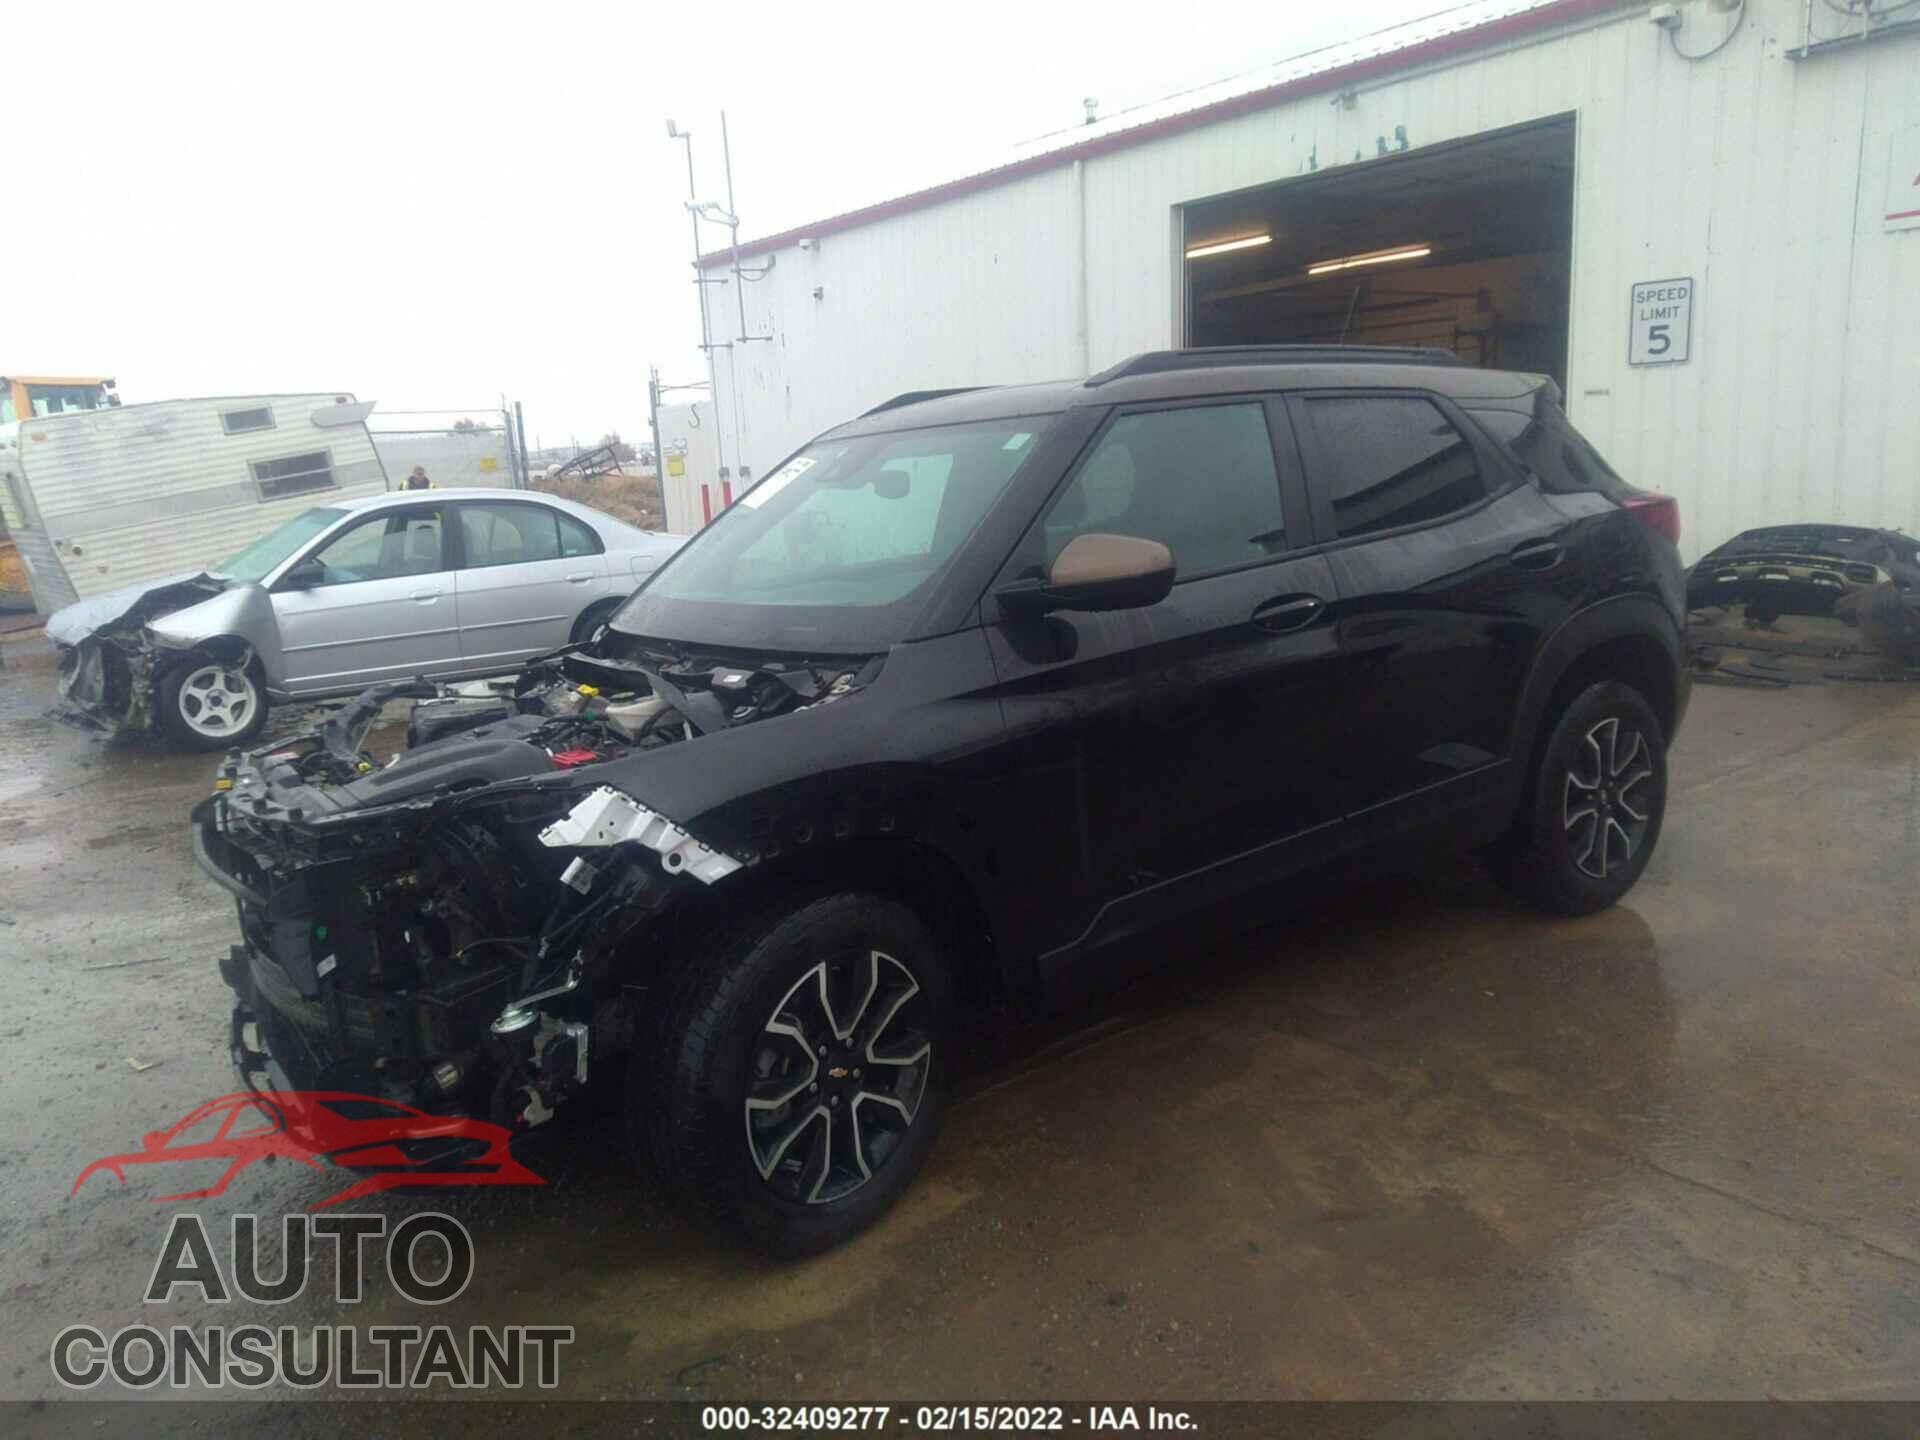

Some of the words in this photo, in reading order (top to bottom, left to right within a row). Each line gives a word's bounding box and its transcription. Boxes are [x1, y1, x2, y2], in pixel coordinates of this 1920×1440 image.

[1636, 287, 1688, 303] SPEED
[1640, 306, 1680, 320] LIMIT
[1648, 324, 1671, 354] 5
